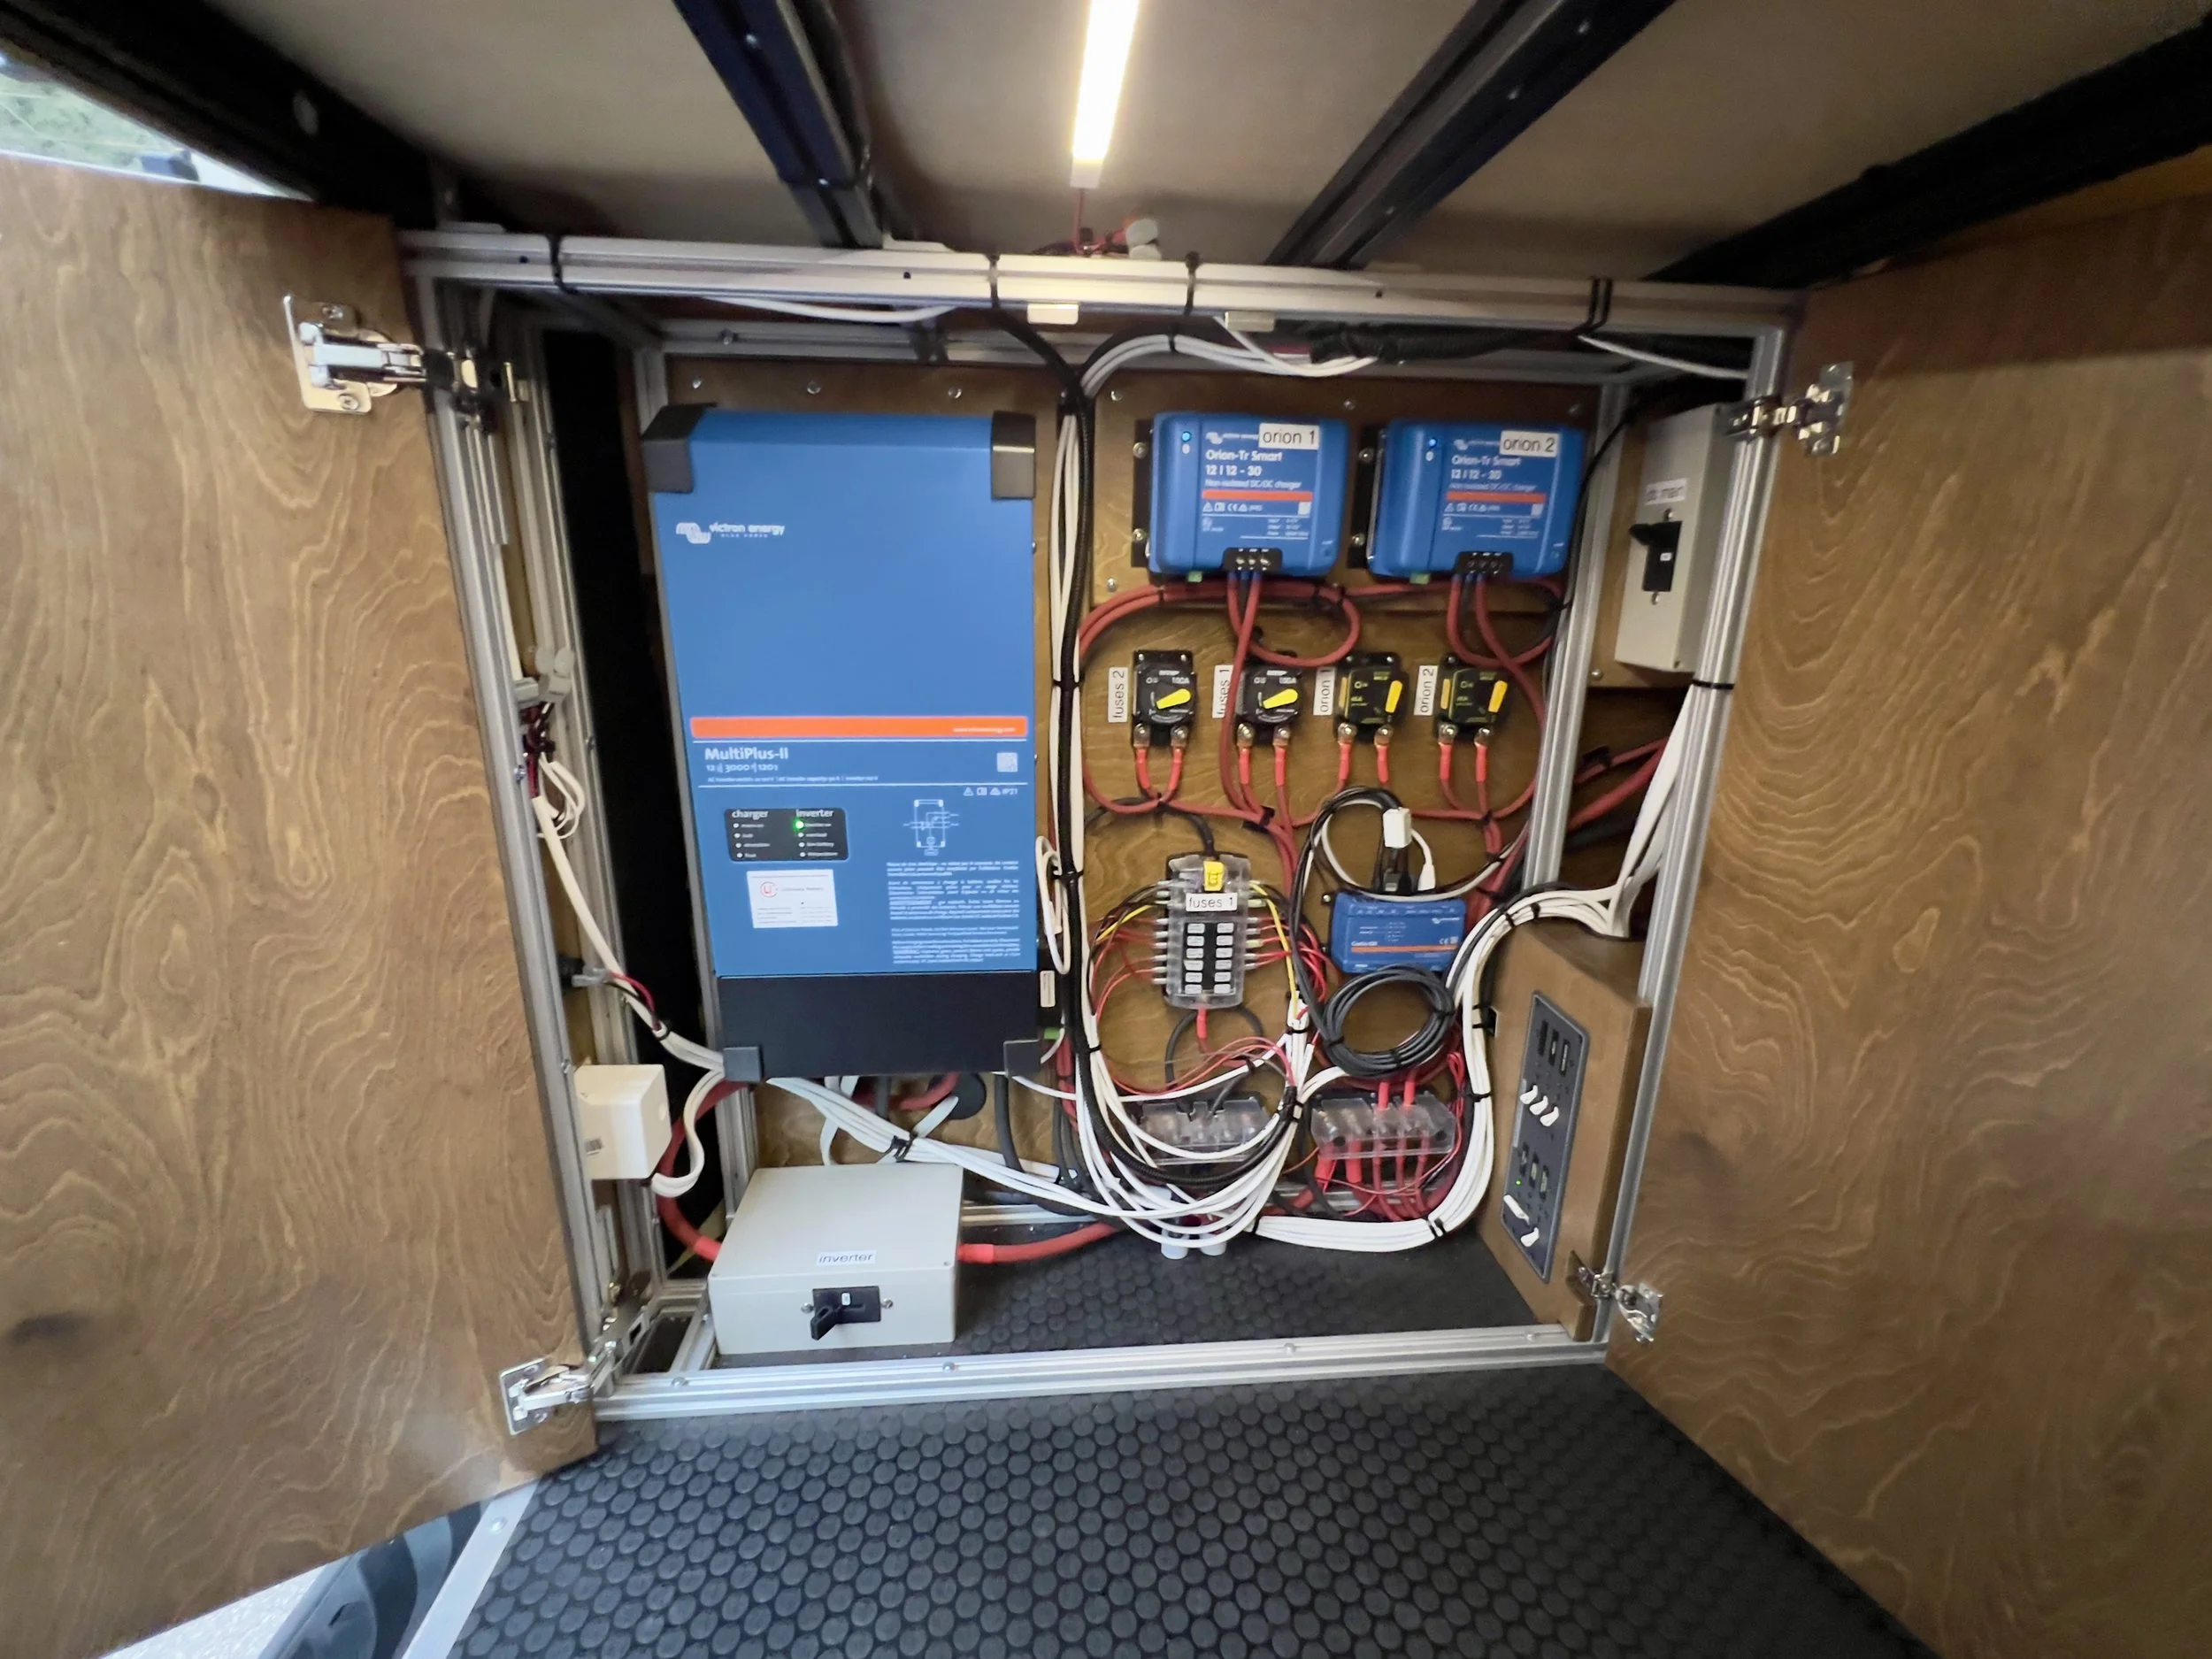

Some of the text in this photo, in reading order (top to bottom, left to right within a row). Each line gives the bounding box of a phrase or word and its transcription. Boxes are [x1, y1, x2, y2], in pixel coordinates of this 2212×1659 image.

[1263, 428, 1302, 443] orion
[1309, 430, 1316, 443] 1
[1503, 437, 1555, 452] orion 2
[1205, 449, 1283, 461] Orion-Tr Smart
[1206, 465, 1217, 475] 12
[1226, 465, 1237, 475] 12
[709, 522, 746, 533] victron
[748, 525, 785, 535] energy
[1112, 670, 1125, 718] fuses 2
[704, 747, 789, 760] MultiPlus-II
[732, 809, 769, 820] charger
[795, 809, 833, 818] inverter
[1188, 896, 1223, 908] fuses
[819, 1253, 872, 1263] inverter
